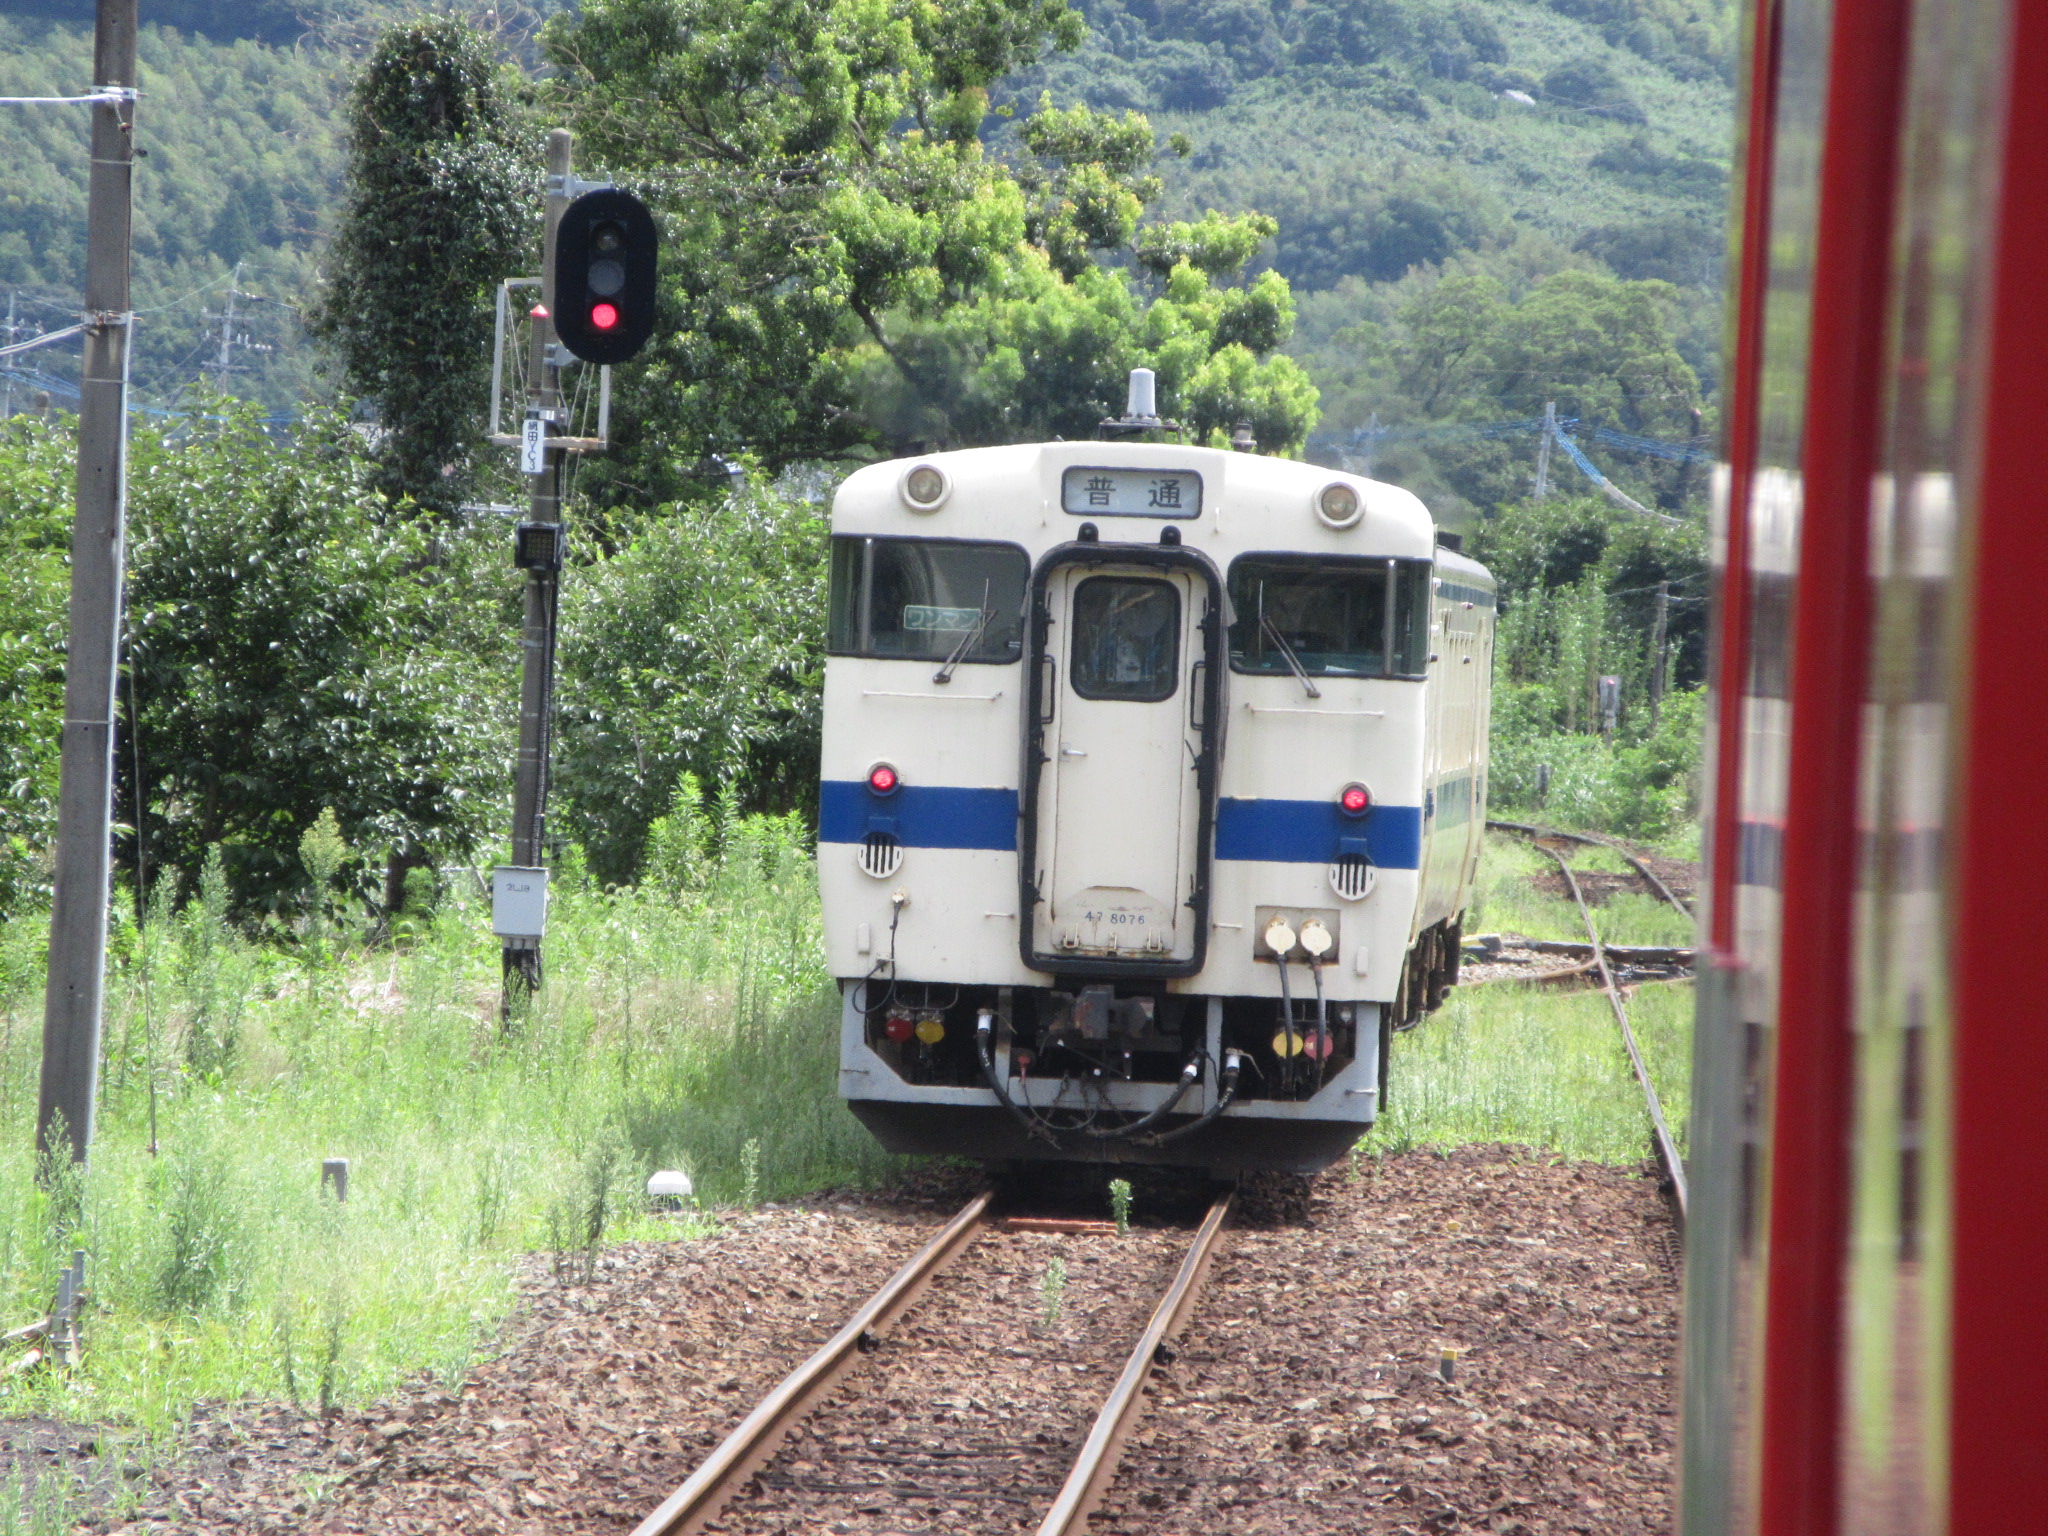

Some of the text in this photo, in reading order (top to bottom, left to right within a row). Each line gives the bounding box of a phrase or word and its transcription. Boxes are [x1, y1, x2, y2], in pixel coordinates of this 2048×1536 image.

[1084, 476, 1182, 508] 普通
[908, 609, 976, 628] ワンマン
[1085, 911, 1145, 925] 47 8076
